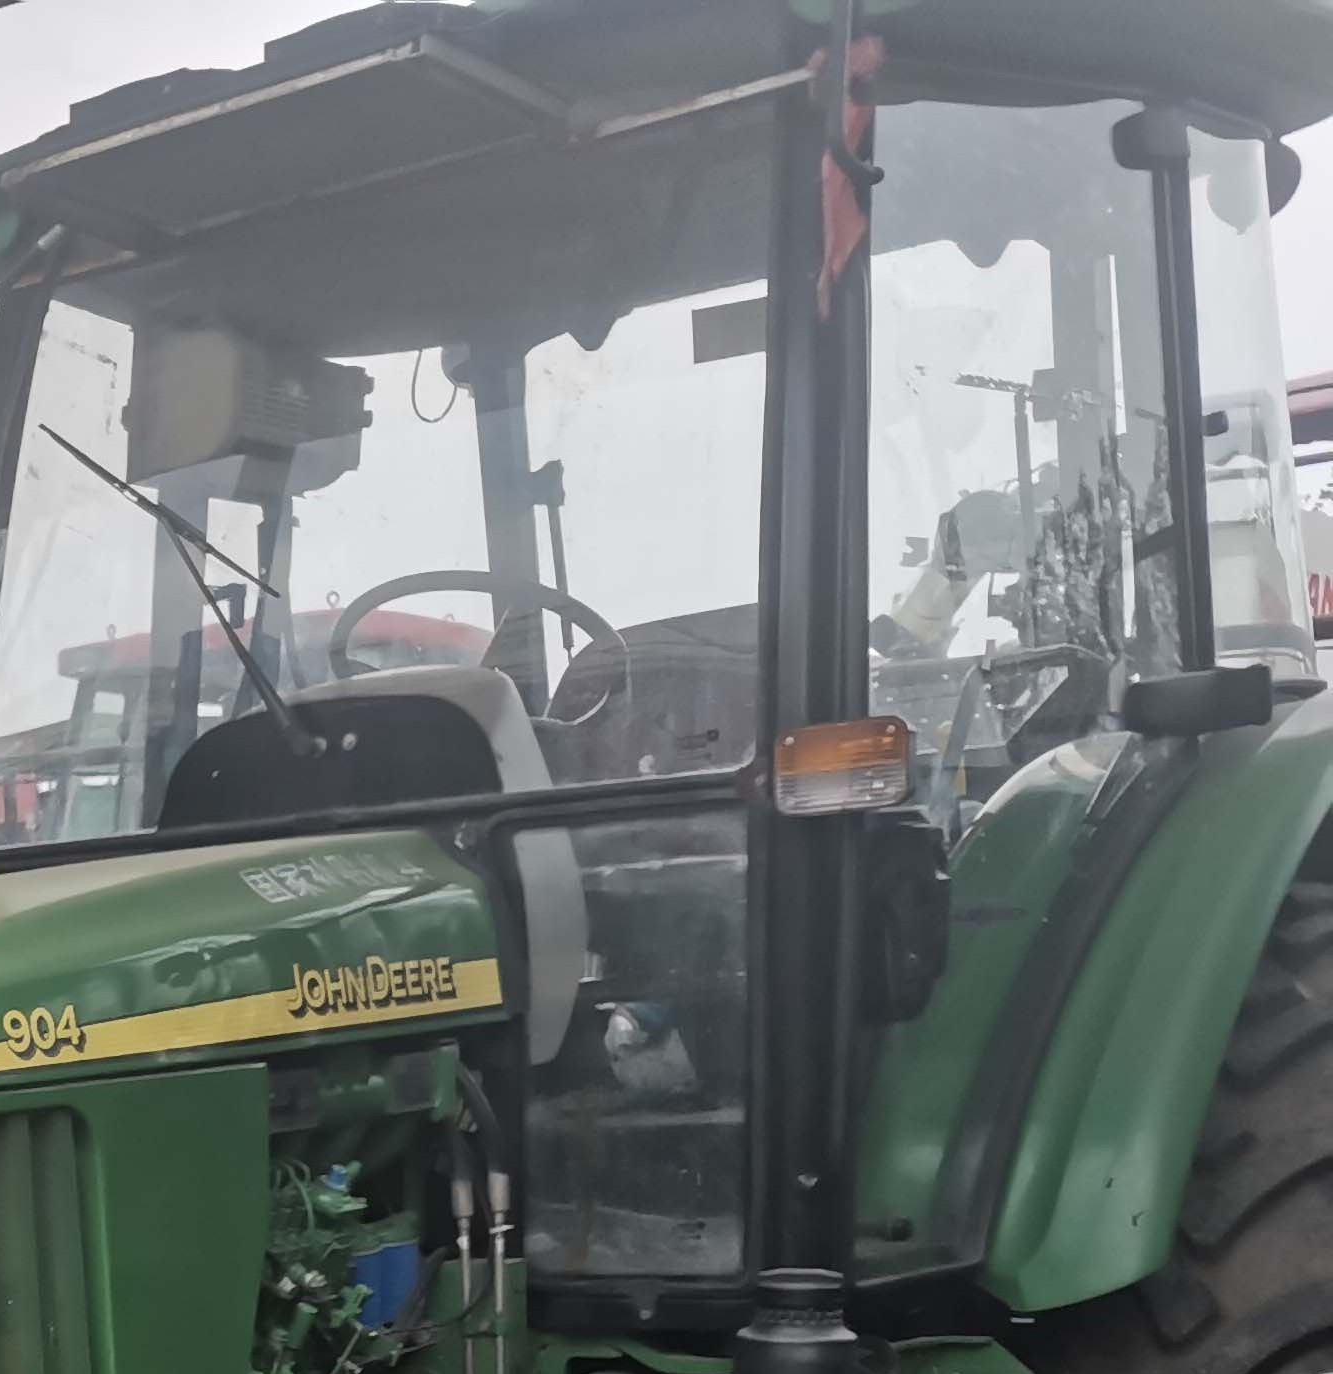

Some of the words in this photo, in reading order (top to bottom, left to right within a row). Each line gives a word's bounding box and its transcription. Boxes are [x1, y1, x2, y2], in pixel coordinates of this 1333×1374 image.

[287, 963, 367, 1015] JOHN
[366, 955, 456, 1004] DEERE
[2, 1004, 85, 1058] 904
